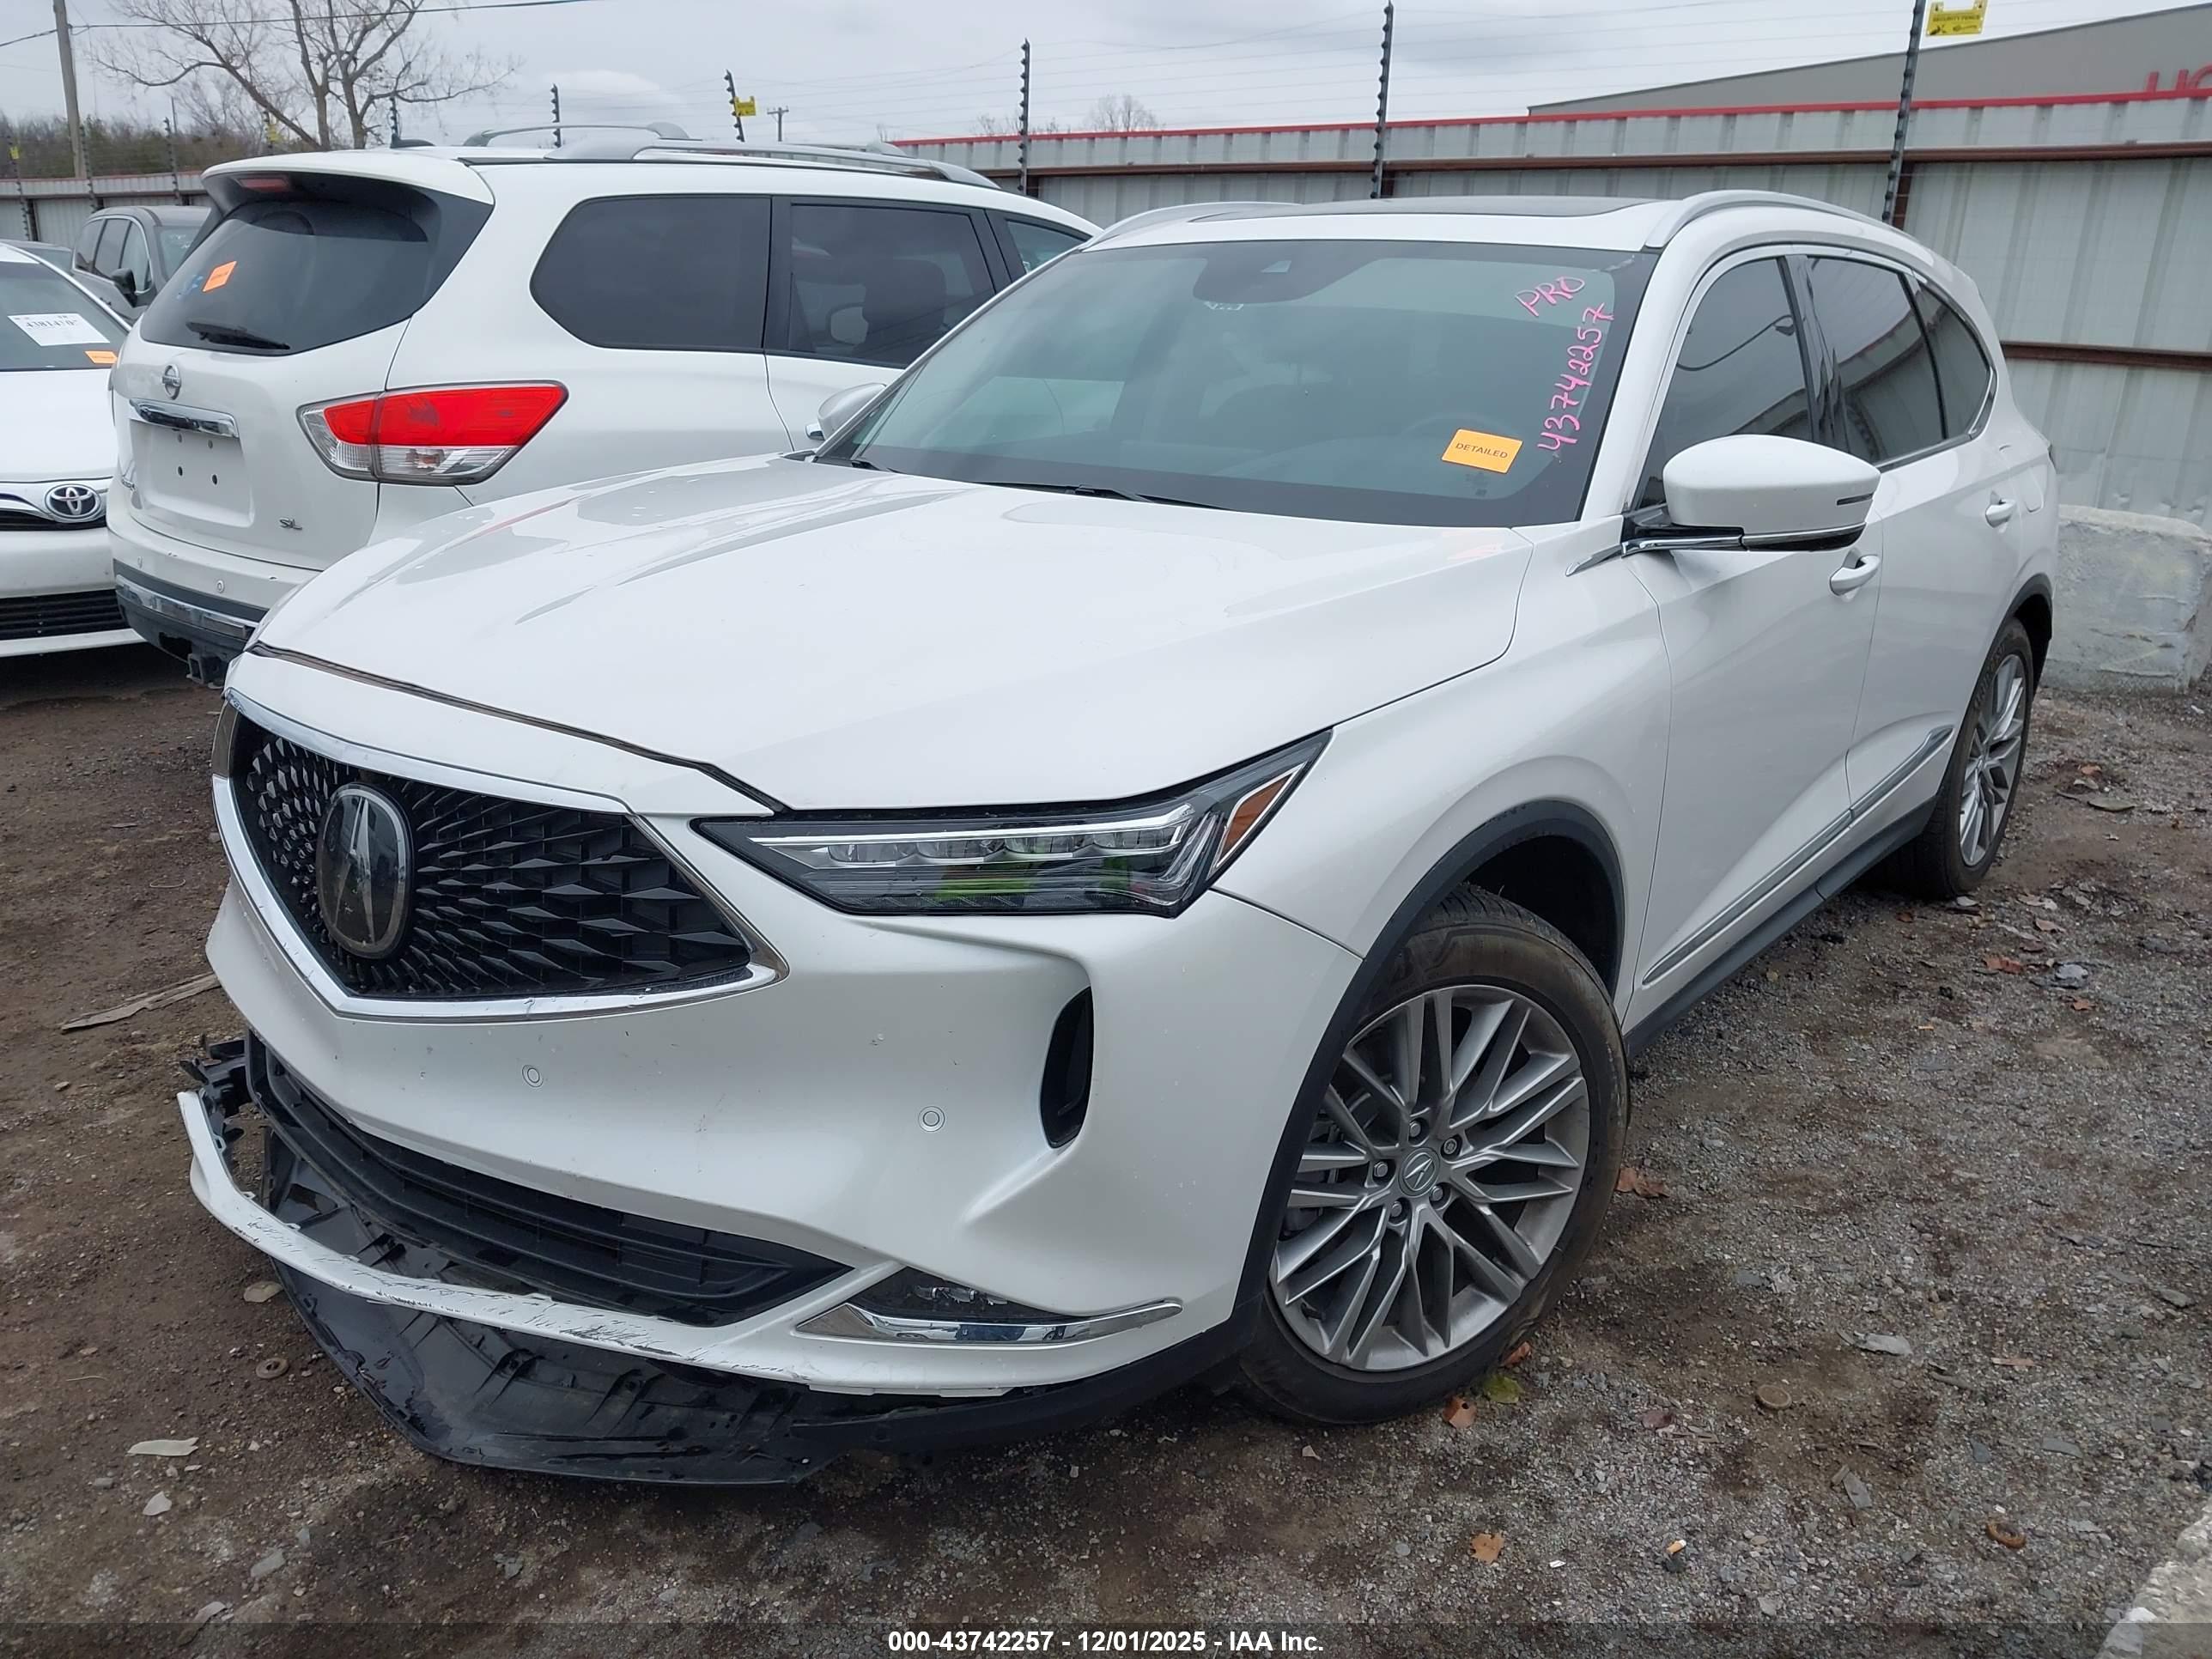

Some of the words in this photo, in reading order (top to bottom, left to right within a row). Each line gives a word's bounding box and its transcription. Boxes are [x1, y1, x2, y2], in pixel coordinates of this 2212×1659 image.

[1536, 302, 1614, 451] 43742257
[1455, 442, 1509, 459] DETAILED
[279, 517, 303, 531] SL
